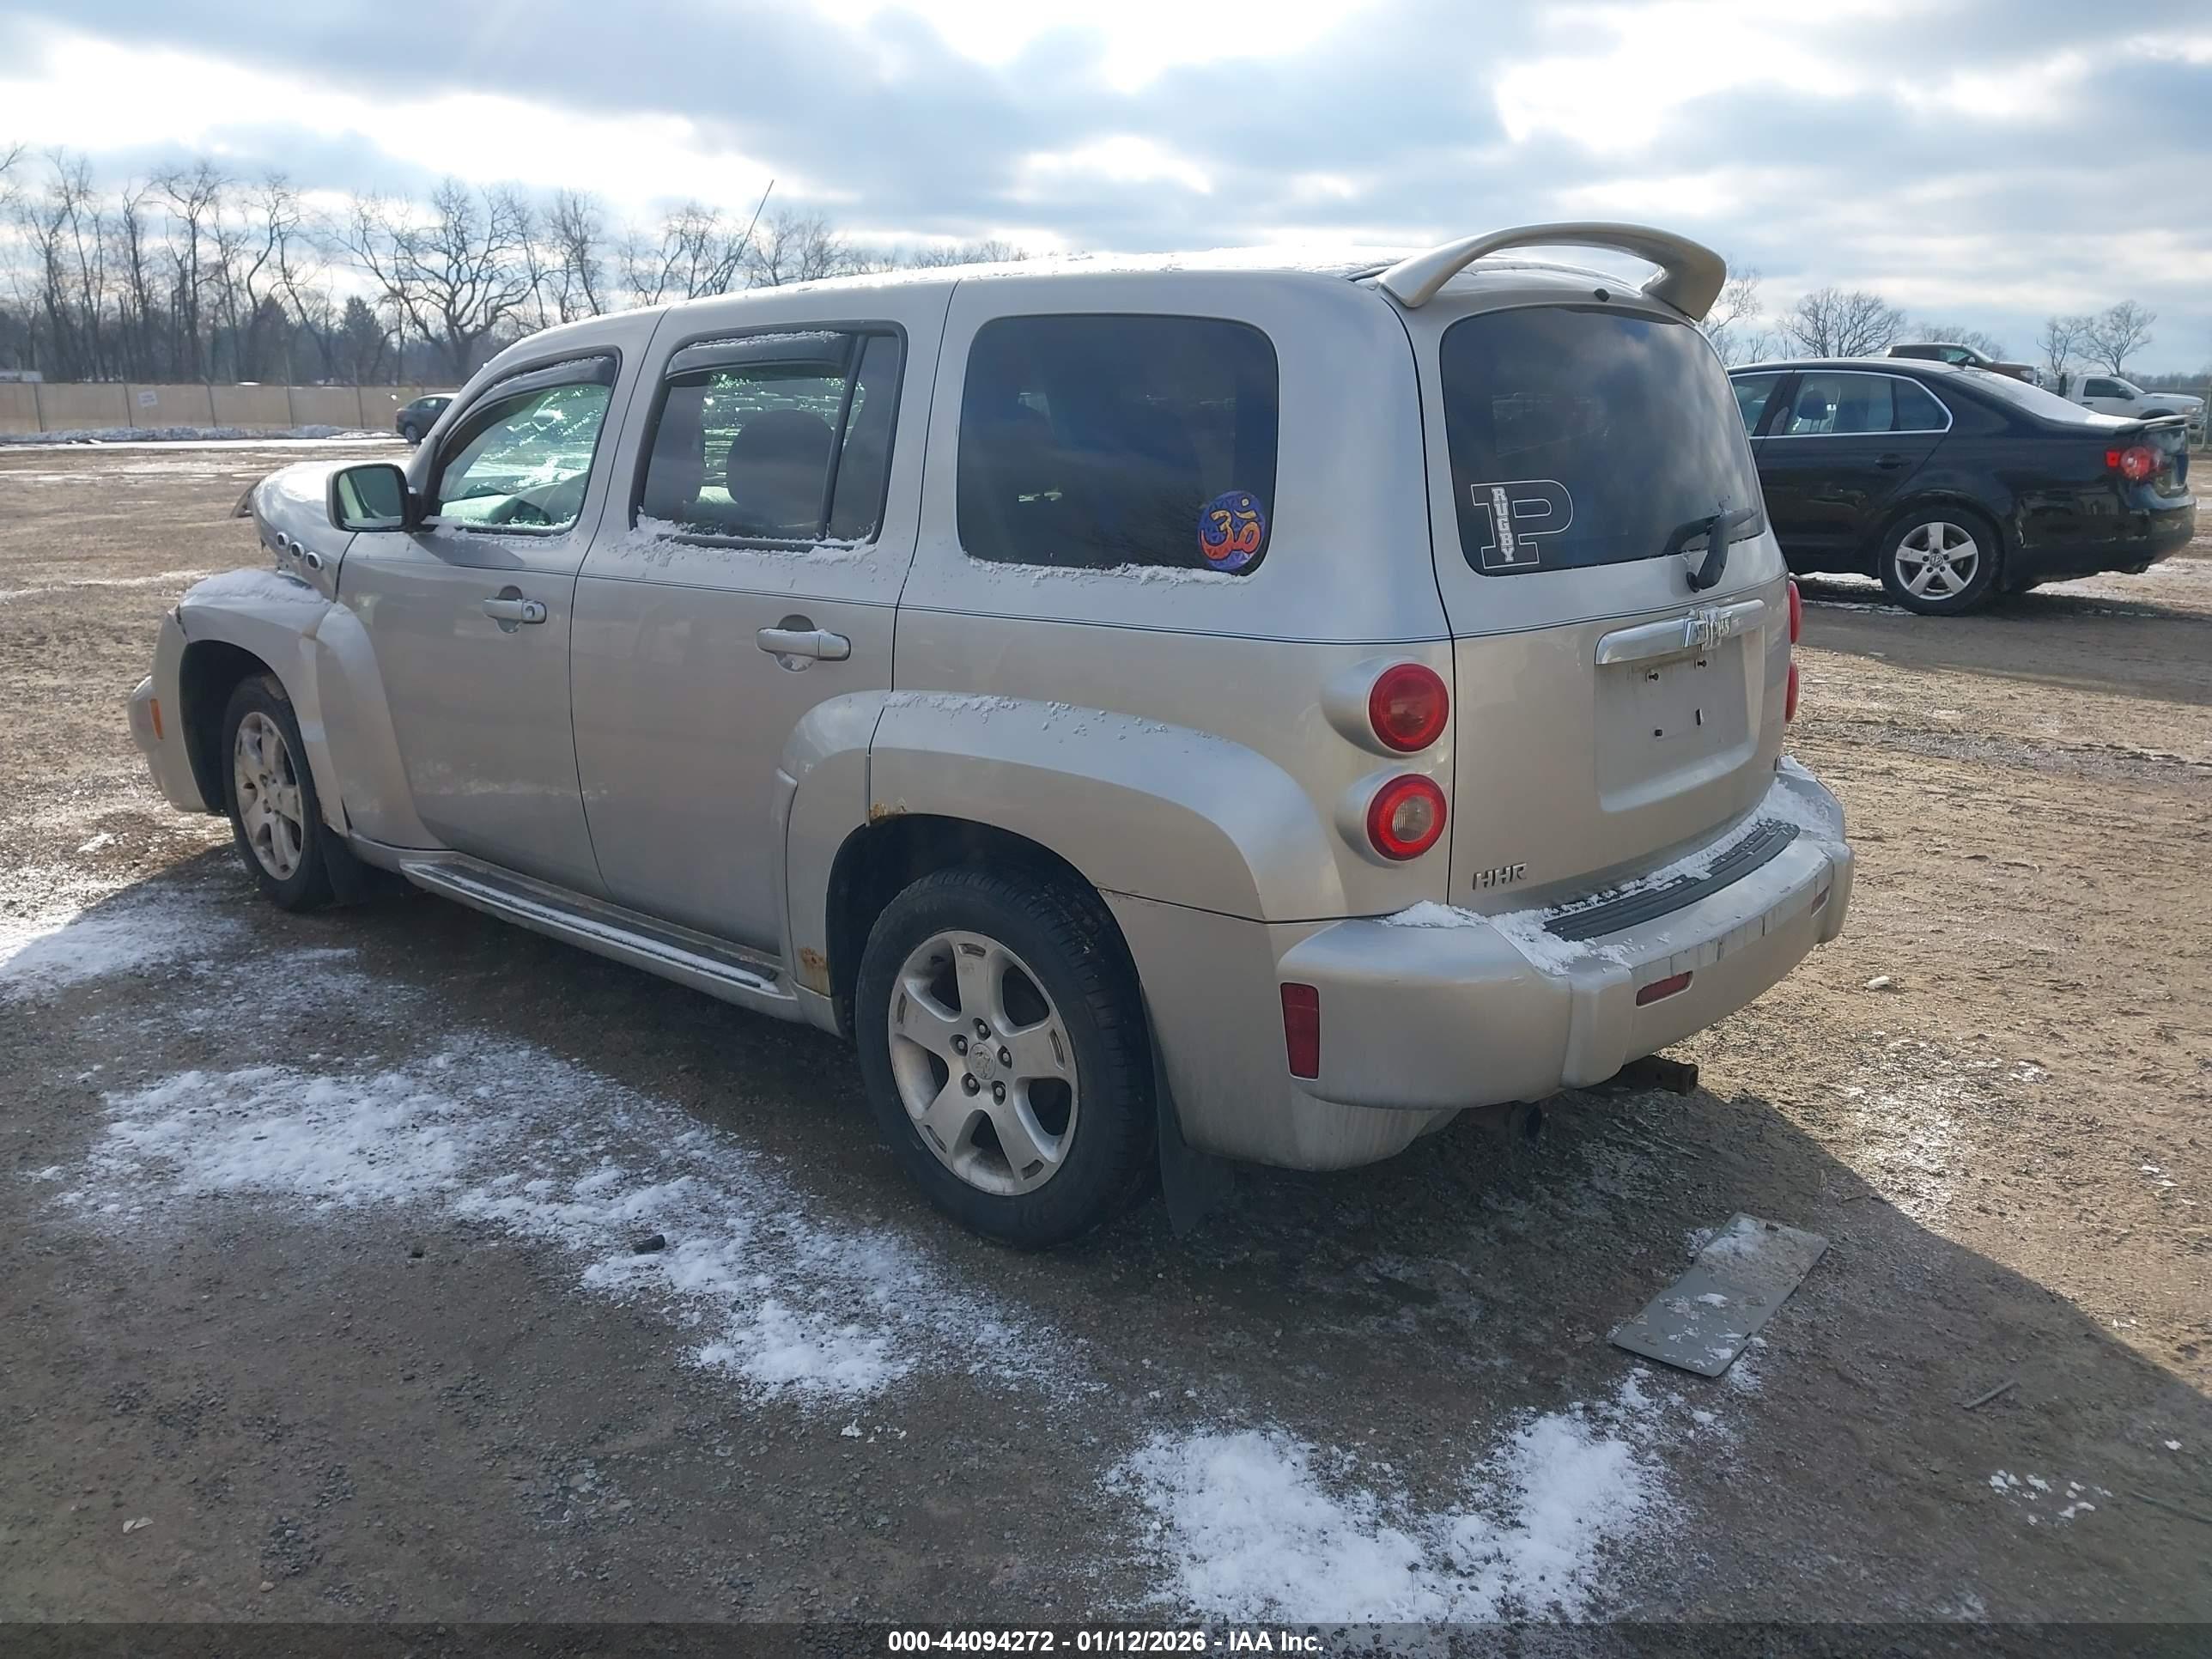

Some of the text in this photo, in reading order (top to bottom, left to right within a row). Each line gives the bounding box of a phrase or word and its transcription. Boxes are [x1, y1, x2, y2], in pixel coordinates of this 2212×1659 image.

[1470, 479, 1574, 569] P
[1491, 486, 1516, 562] RUGBY
[1472, 862, 1528, 890] HHR
